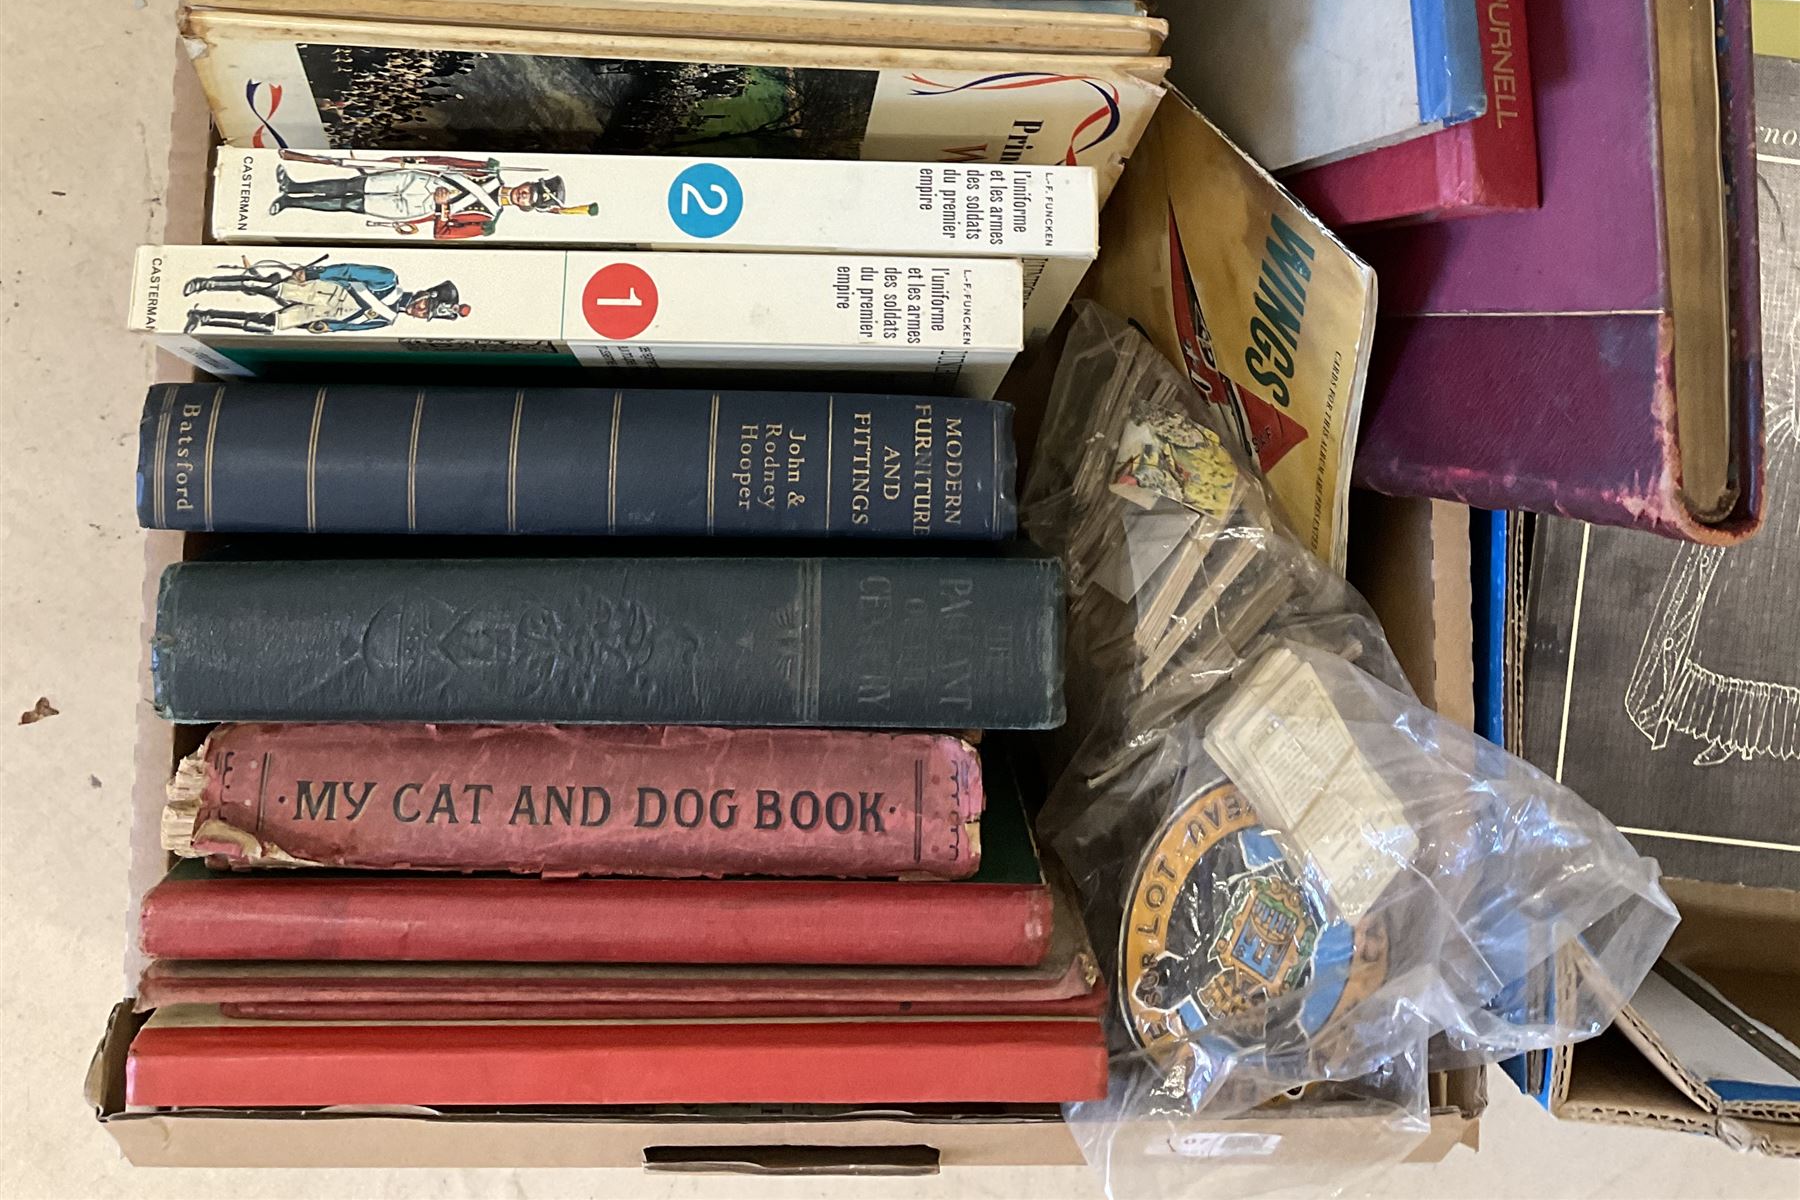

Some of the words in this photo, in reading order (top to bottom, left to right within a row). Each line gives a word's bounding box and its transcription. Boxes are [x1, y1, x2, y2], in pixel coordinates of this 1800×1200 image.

[237, 156, 254, 231] CASTERMAN
[915, 168, 938, 210] empire
[943, 169, 961, 183] du
[966, 169, 985, 190] des
[990, 170, 1006, 181] et
[990, 186, 1008, 203] les
[682, 185, 728, 216] 2
[939, 190, 961, 239] premier
[966, 195, 984, 240] soldats
[1013, 170, 1032, 232] l'uniforme
[1045, 196, 1053, 246] FUNCKEN
[990, 206, 1003, 245] armes
[832, 266, 855, 309] empire
[861, 267, 879, 281] du
[884, 267, 902, 288] des
[907, 267, 924, 279] et
[907, 284, 926, 300] les
[596, 287, 642, 306] 1
[856, 288, 879, 338] premier
[883, 294, 902, 339] soldats
[931, 268, 950, 331] l'uniforme
[1245, 213, 1315, 407] WINGS
[907, 305, 921, 344] armes
[963, 294, 972, 345] FUNCKEN
[1331, 351, 1342, 386] CARDS
[1326, 387, 1337, 411] FOR
[1323, 411, 1332, 437] THIS
[176, 403, 201, 512] Batsford
[733, 423, 758, 510] Hooper
[758, 423, 783, 511] Rodney
[787, 430, 807, 482] John
[852, 411, 872, 525] FITTINGS
[883, 445, 900, 501] AND
[912, 404, 932, 536] FURNITURE
[944, 417, 962, 526] MODERN
[1318, 438, 1328, 475] ALBUM
[787, 491, 805, 508] &
[292, 780, 378, 821] MY
[393, 782, 494, 825] CAT
[509, 785, 611, 827] AND
[634, 786, 738, 830] DOG
[754, 789, 886, 832] BOOK
